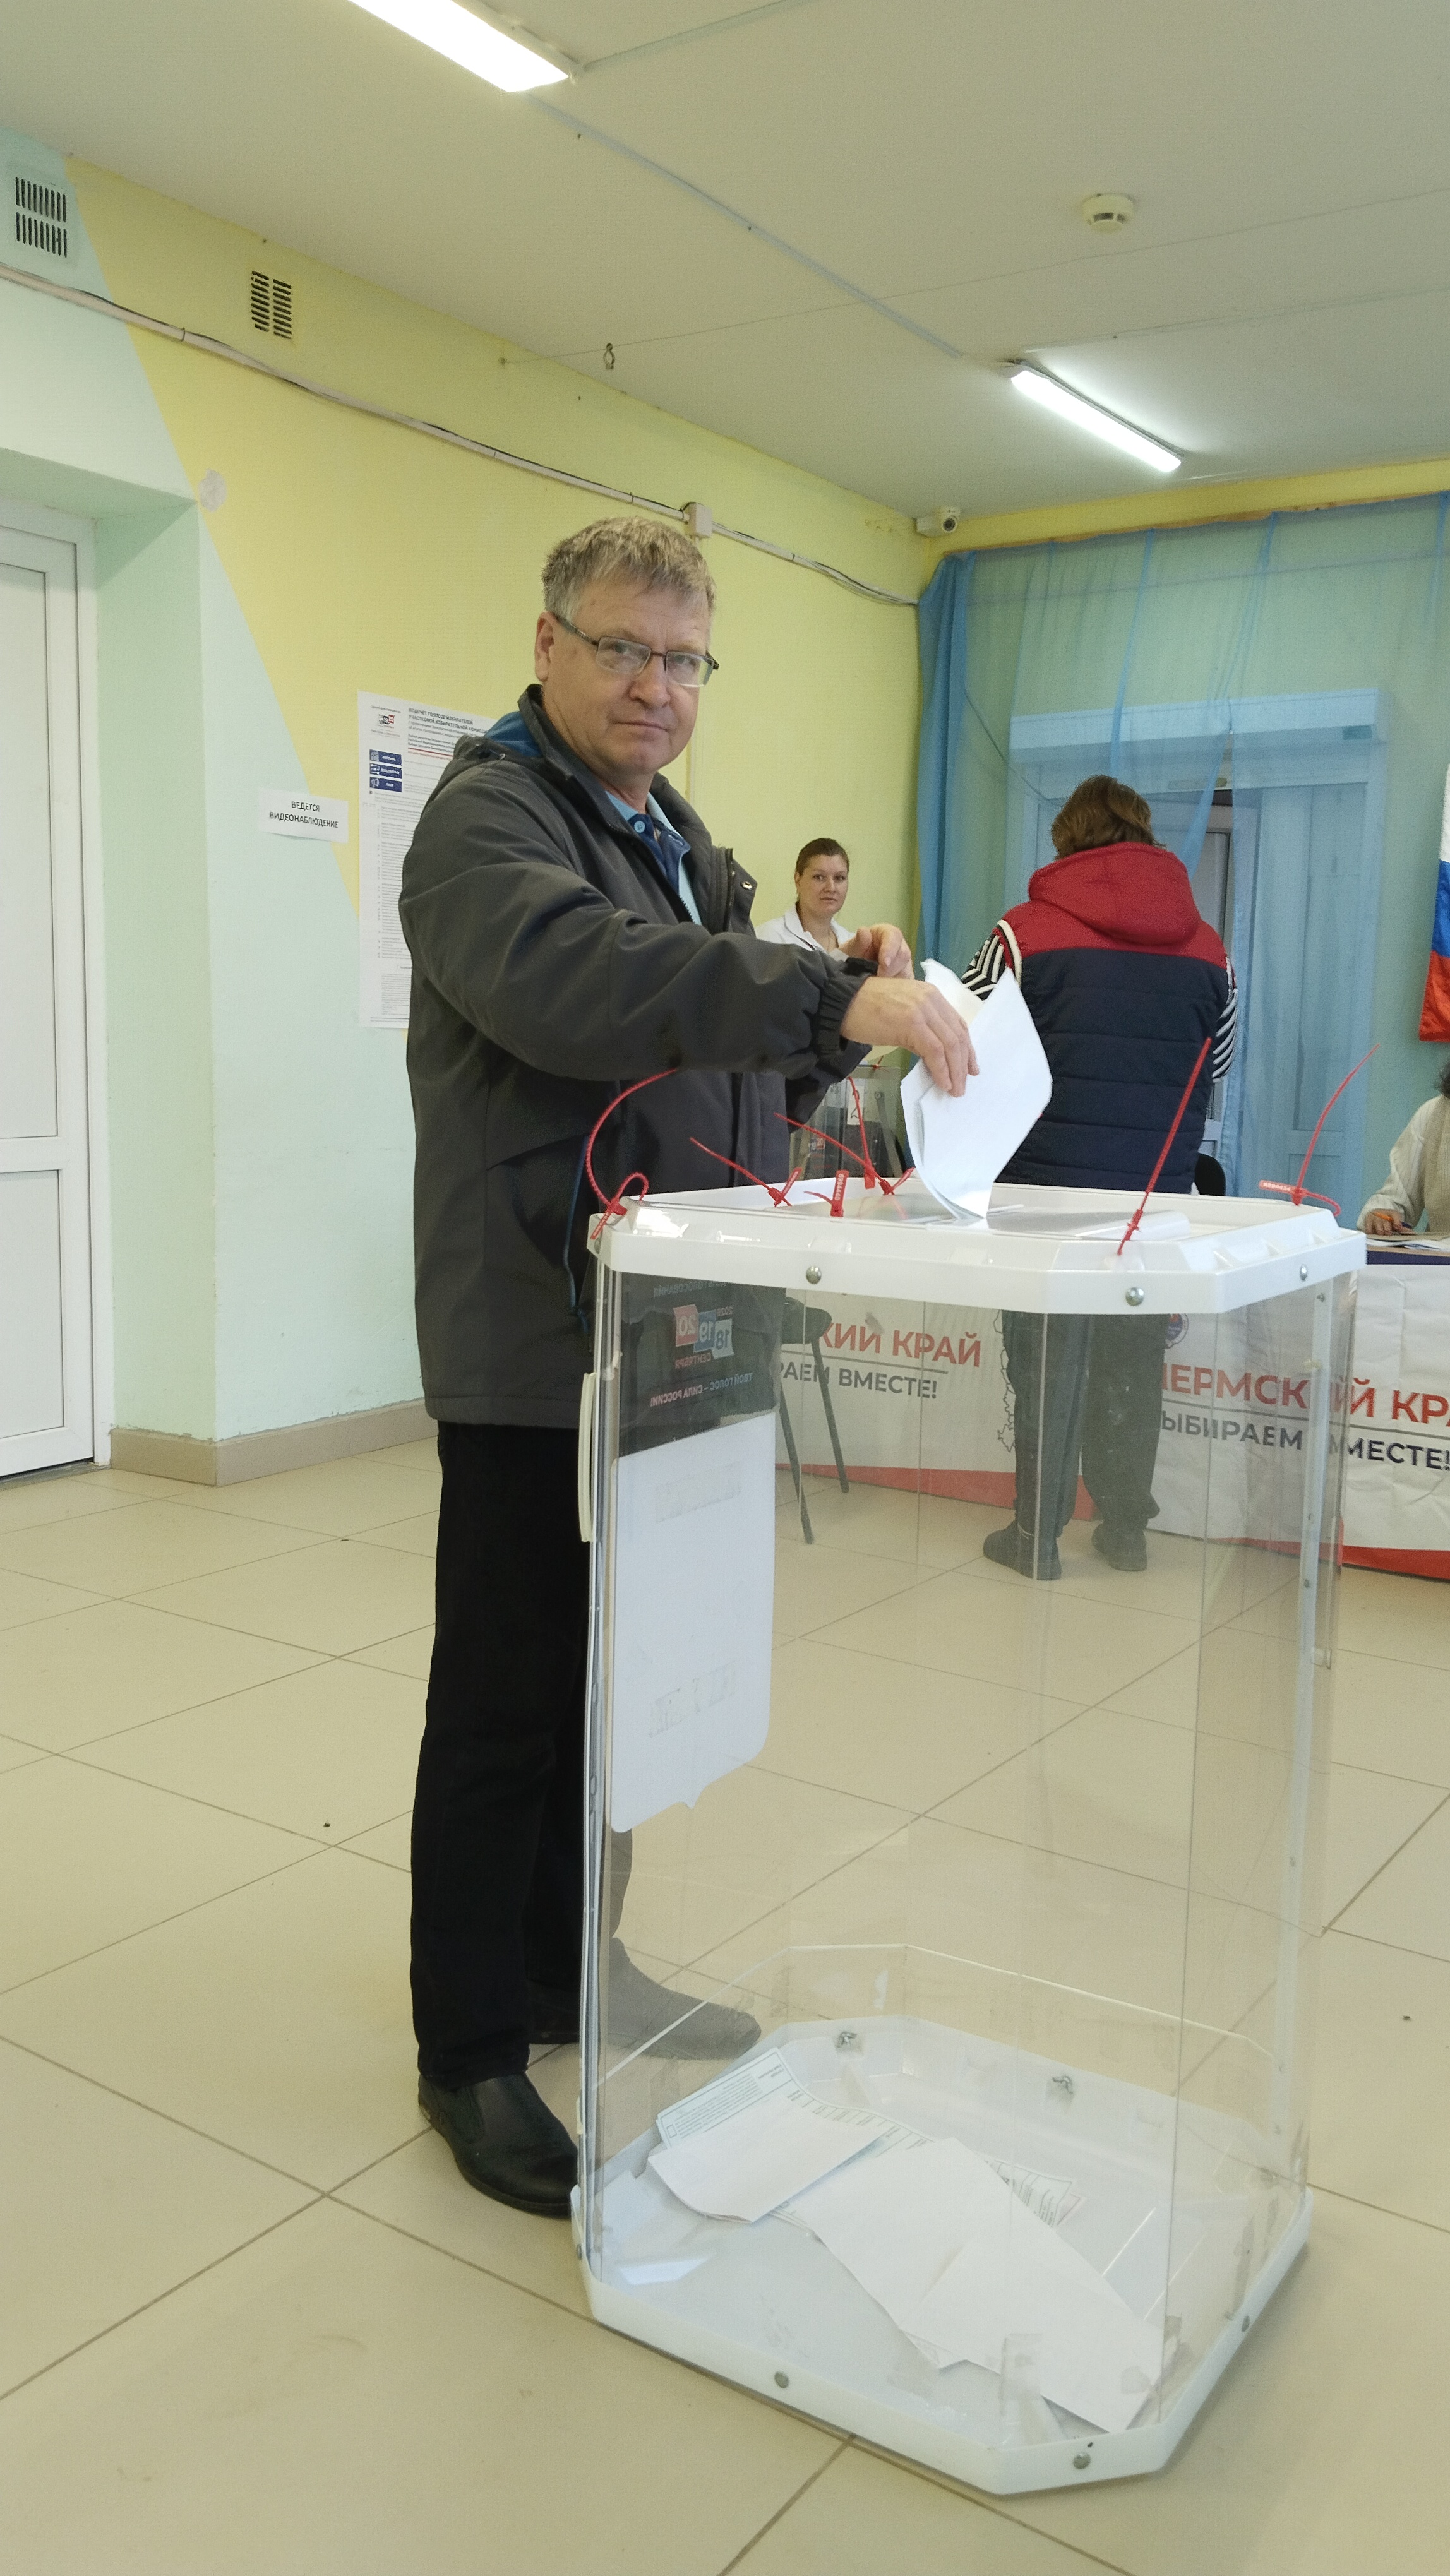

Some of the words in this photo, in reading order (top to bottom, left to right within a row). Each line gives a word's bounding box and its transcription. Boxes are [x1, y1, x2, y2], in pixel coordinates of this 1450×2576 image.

[270, 812, 338, 828] ВИДЕОНАБЛЮДЕНИЕ
[292, 801, 320, 812] ВЕДЕТСЯ
[892, 1330, 981, 1367] КРАЙ
[839, 1368, 937, 1399] ВМЕСТЕ!
[1392, 1390, 1450, 1427] КР
